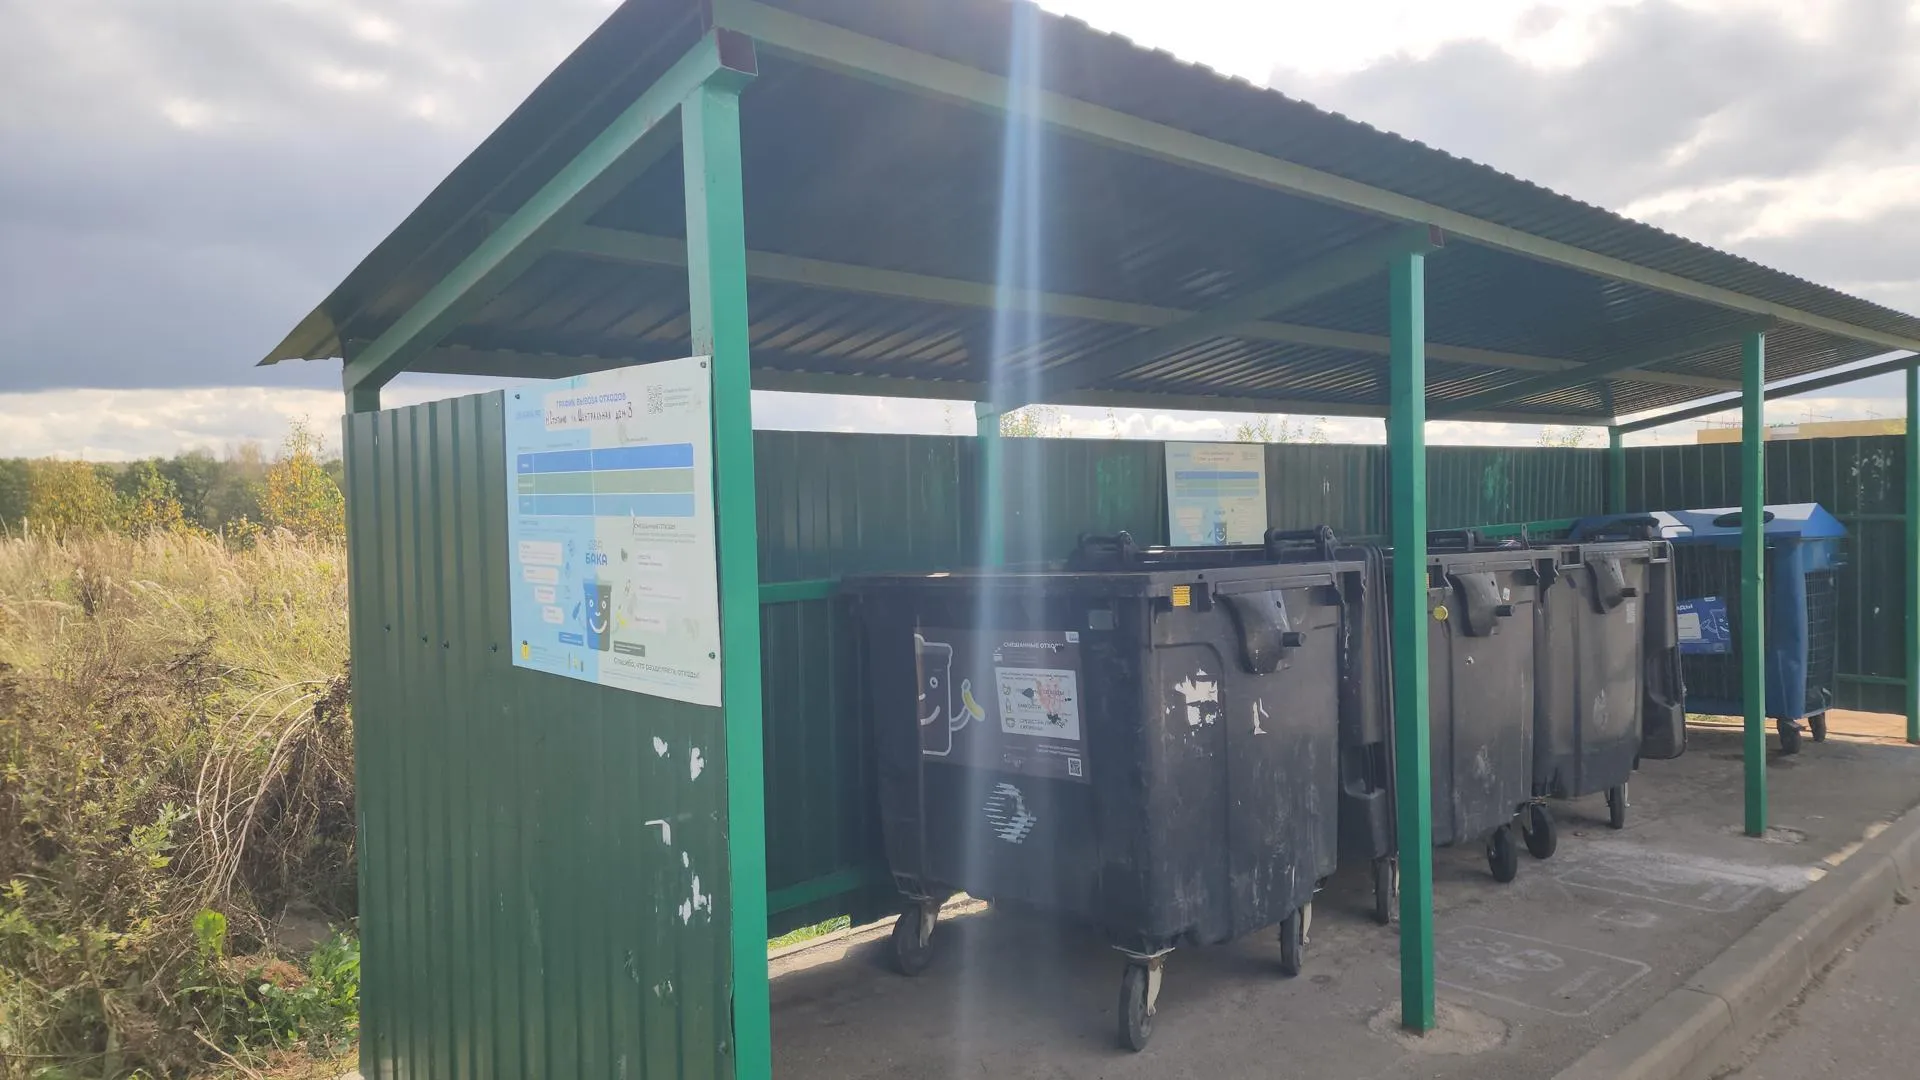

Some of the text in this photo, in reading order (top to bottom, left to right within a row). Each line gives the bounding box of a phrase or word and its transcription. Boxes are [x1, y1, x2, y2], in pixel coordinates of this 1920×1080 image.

[576, 396, 598, 406] ВЫВОЗА
[598, 392, 627, 403] ОТХОДОВ
[585, 552, 609, 566] БАКА
